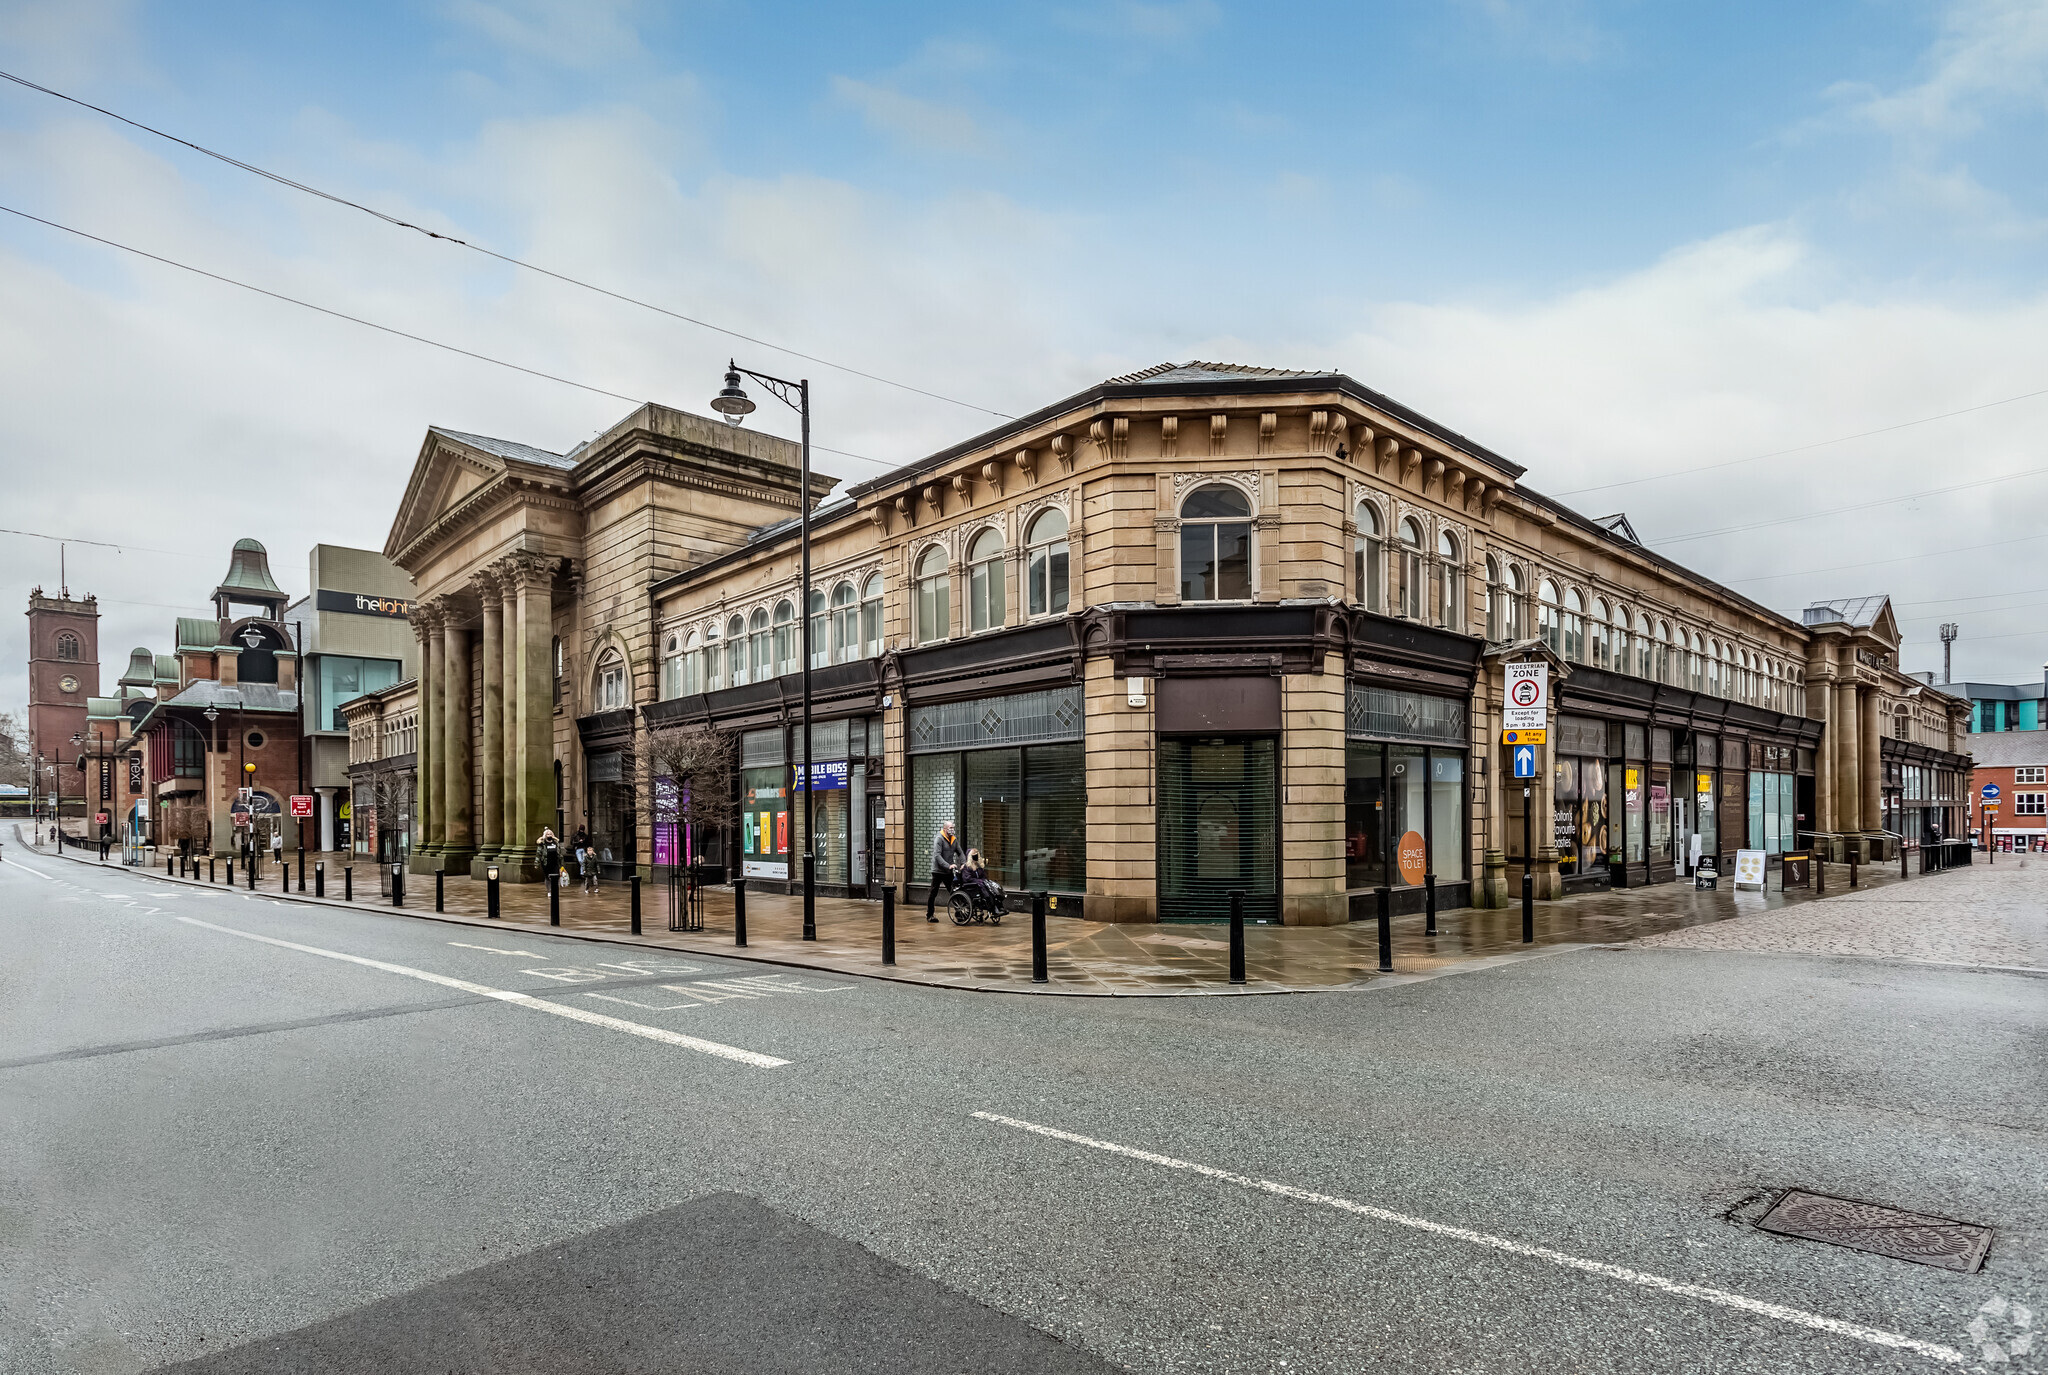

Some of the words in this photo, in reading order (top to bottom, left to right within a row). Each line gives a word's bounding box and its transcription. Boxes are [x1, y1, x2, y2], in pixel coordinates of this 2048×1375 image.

[1513, 670, 1539, 678] ZONE
[130, 757, 141, 786] next
[798, 764, 825, 776] MBILE
[827, 763, 847, 774] BOSS
[1403, 849, 1423, 859] SPACE
[1403, 860, 1412, 869] TO
[1413, 858, 1424, 869] LET
[518, 961, 702, 984] BUS
[584, 974, 857, 1011] LANE
